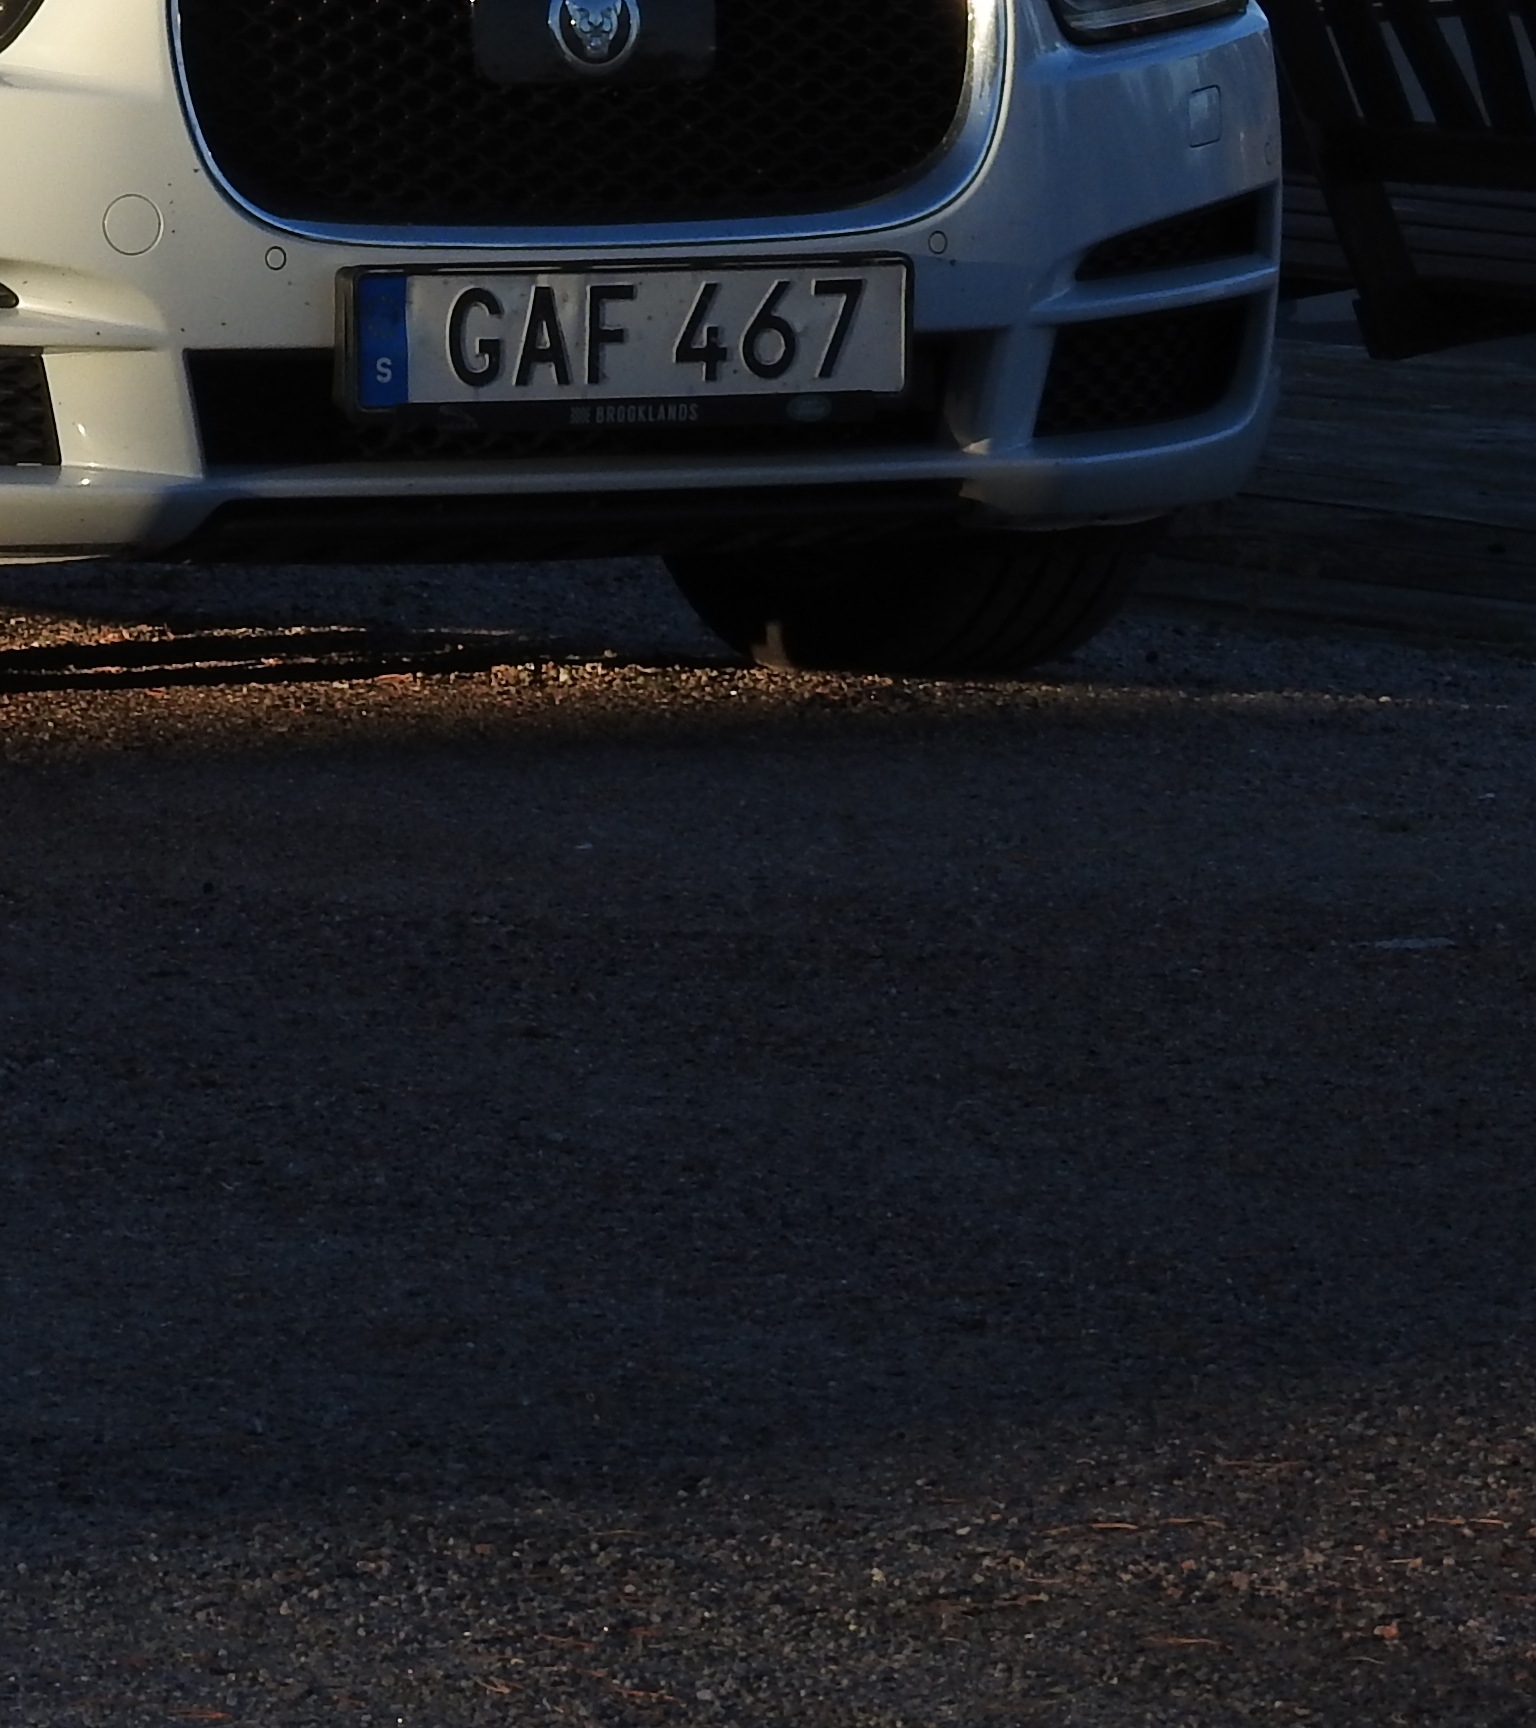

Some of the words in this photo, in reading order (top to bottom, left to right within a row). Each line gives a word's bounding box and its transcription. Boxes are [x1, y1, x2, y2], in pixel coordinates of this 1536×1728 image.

[447, 284, 637, 388] GAF
[673, 279, 865, 382] 467
[375, 356, 393, 384] S
[595, 403, 699, 424] BROOKLANDS
